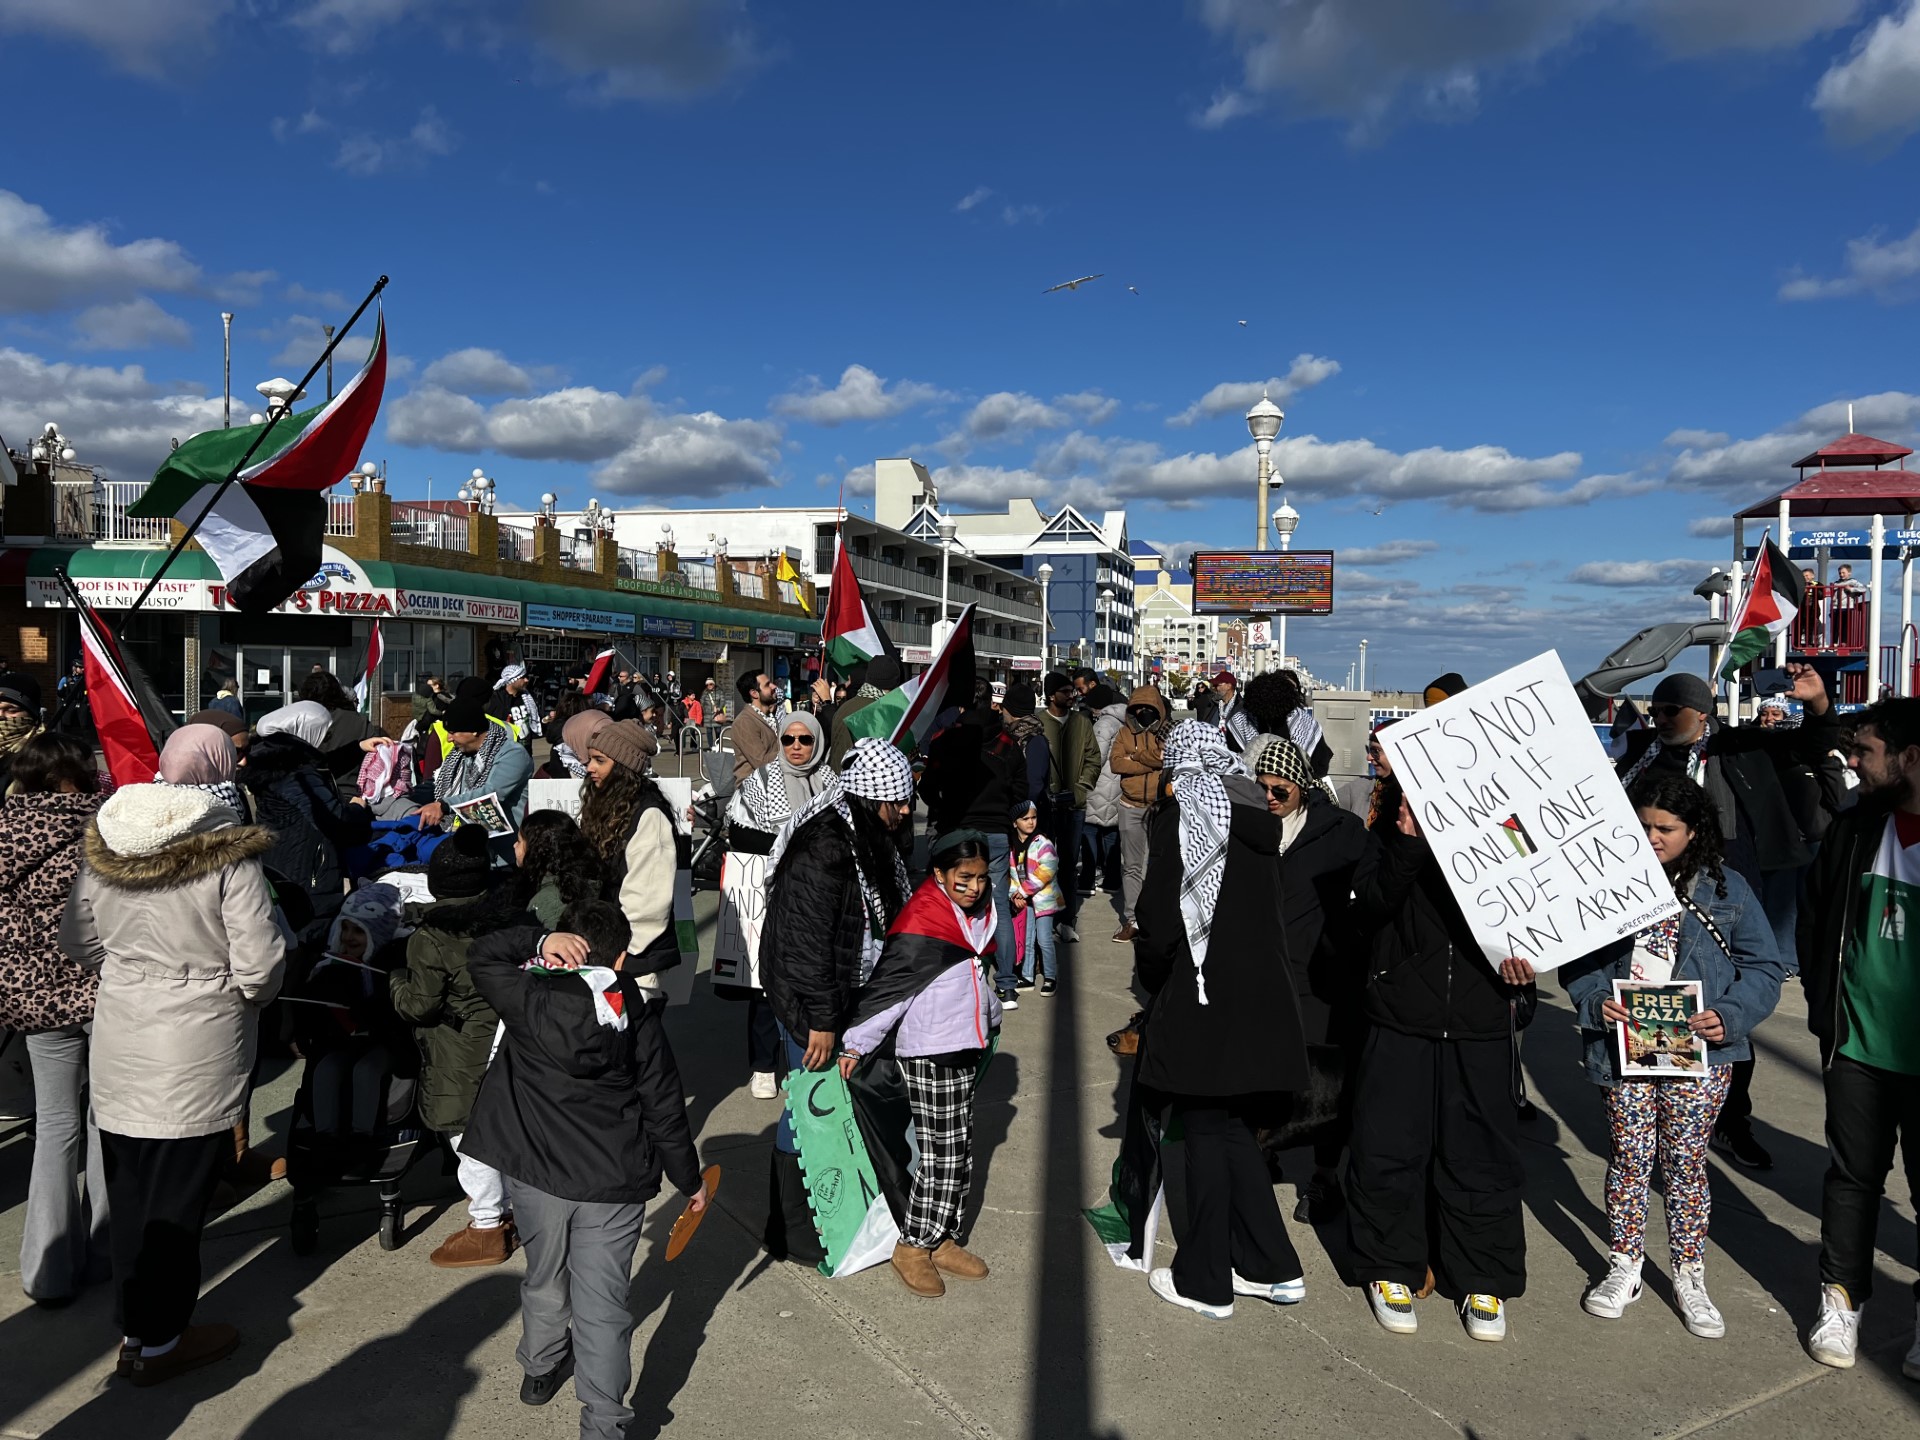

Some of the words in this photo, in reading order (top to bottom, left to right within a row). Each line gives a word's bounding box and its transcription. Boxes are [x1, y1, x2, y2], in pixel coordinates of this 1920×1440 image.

[1801, 538, 1834, 546] OCEAN
[1837, 537, 1861, 545] CITY
[104, 581, 114, 591] IS
[117, 581, 130, 591] IN
[132, 582, 151, 592] TH
[304, 577, 324, 588] WALK
[617, 579, 657, 592] ROOFTOP
[660, 585, 676, 595] BAR
[678, 587, 693, 597] AND
[695, 590, 720, 601] DINING
[318, 590, 392, 612] PIZZA
[408, 593, 440, 609] OCEAN
[442, 596, 465, 611] DECK
[466, 602, 496, 618] TONY'S
[497, 605, 519, 620] PIZZA
[552, 609, 585, 622] SHOPPER'S
[585, 613, 613, 625] PARADISE
[708, 627, 728, 639] FUNNEL
[1395, 717, 1478, 789] IT'S
[1469, 680, 1555, 759] NOT
[1539, 774, 1604, 840] ONE
[1477, 857, 1559, 927] SIDE
[1561, 825, 1640, 885] HAS
[724, 886, 766, 921] AND
[1505, 914, 1563, 958] AN
[1576, 870, 1657, 931] ARMY
[1616, 897, 1678, 935] #FREEPALESTINE
[1632, 993, 1684, 1009] FREE
[1631, 1007, 1688, 1022] GAZA
